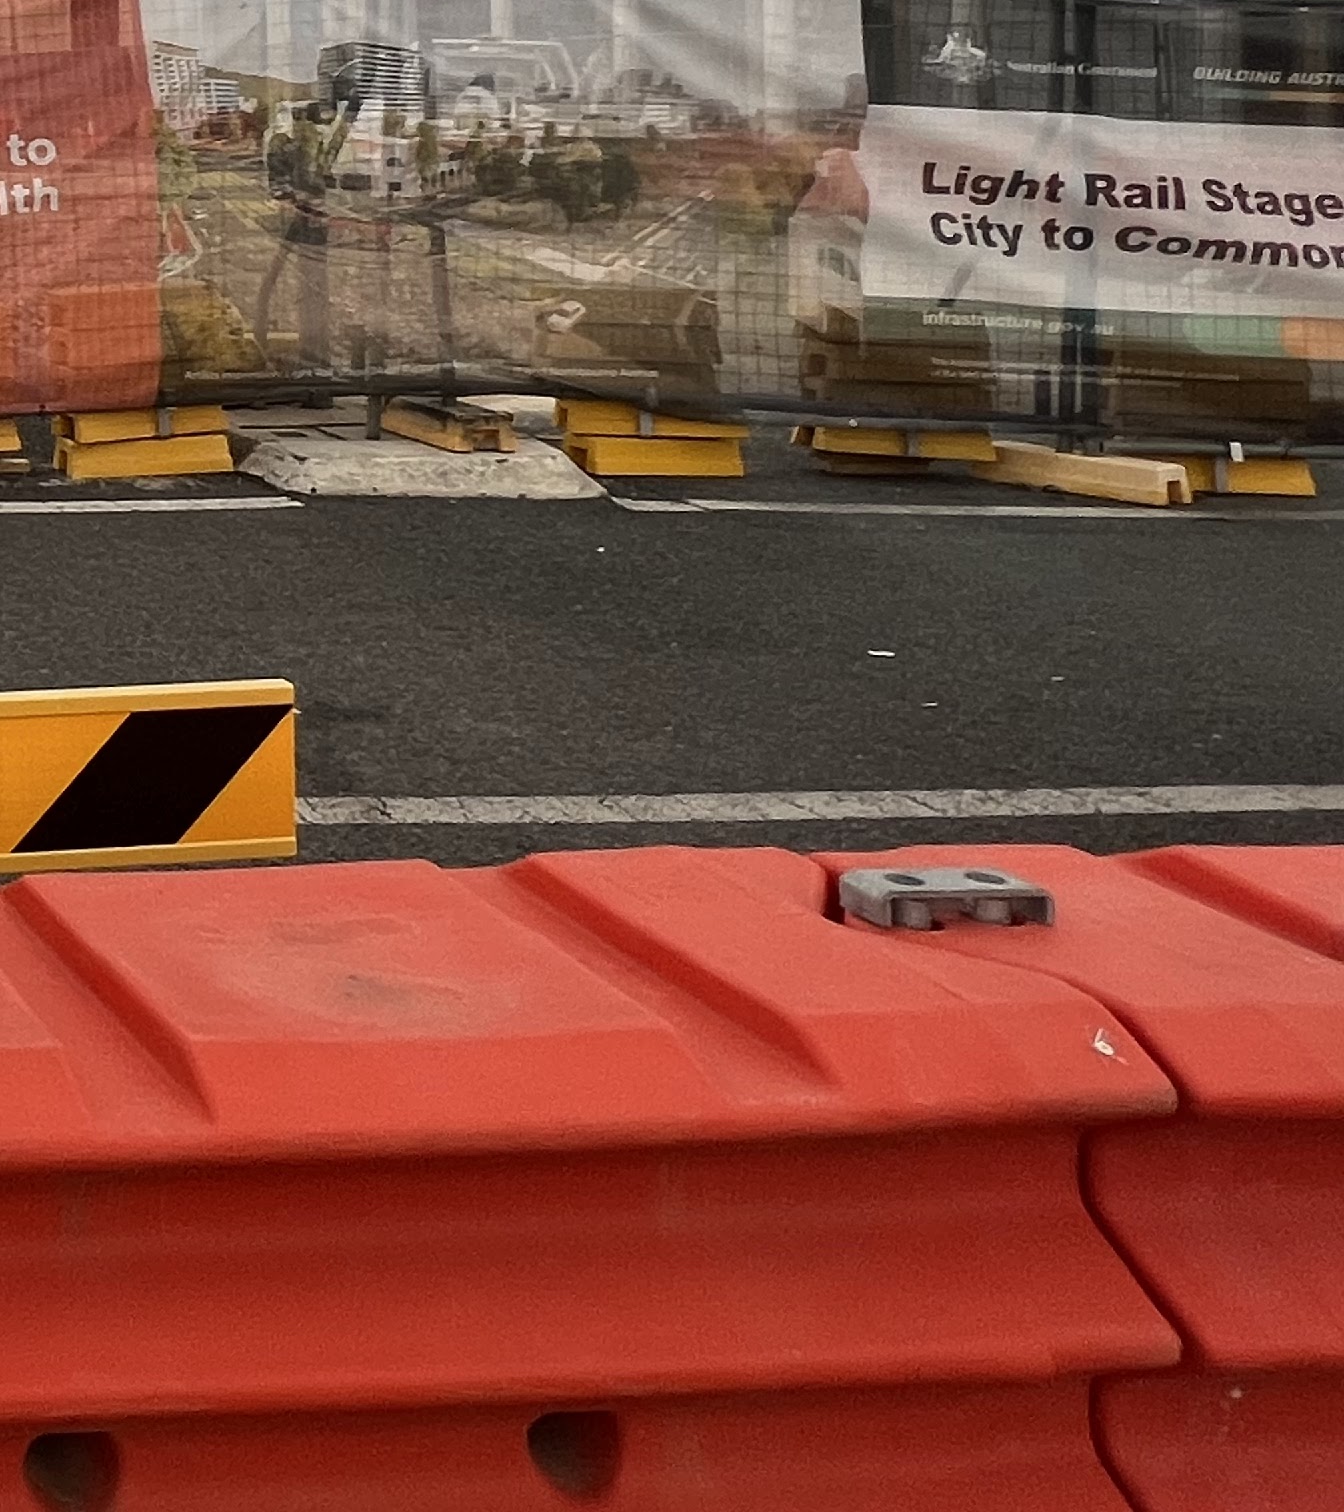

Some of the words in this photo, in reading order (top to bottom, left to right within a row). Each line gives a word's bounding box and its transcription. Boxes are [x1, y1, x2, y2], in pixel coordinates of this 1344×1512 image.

[7, 134, 57, 167] to
[921, 161, 1066, 206] Light
[1084, 172, 1187, 211] Rail
[1200, 178, 1344, 227] Stage
[929, 211, 1024, 257] City
[1040, 217, 1094, 251] to
